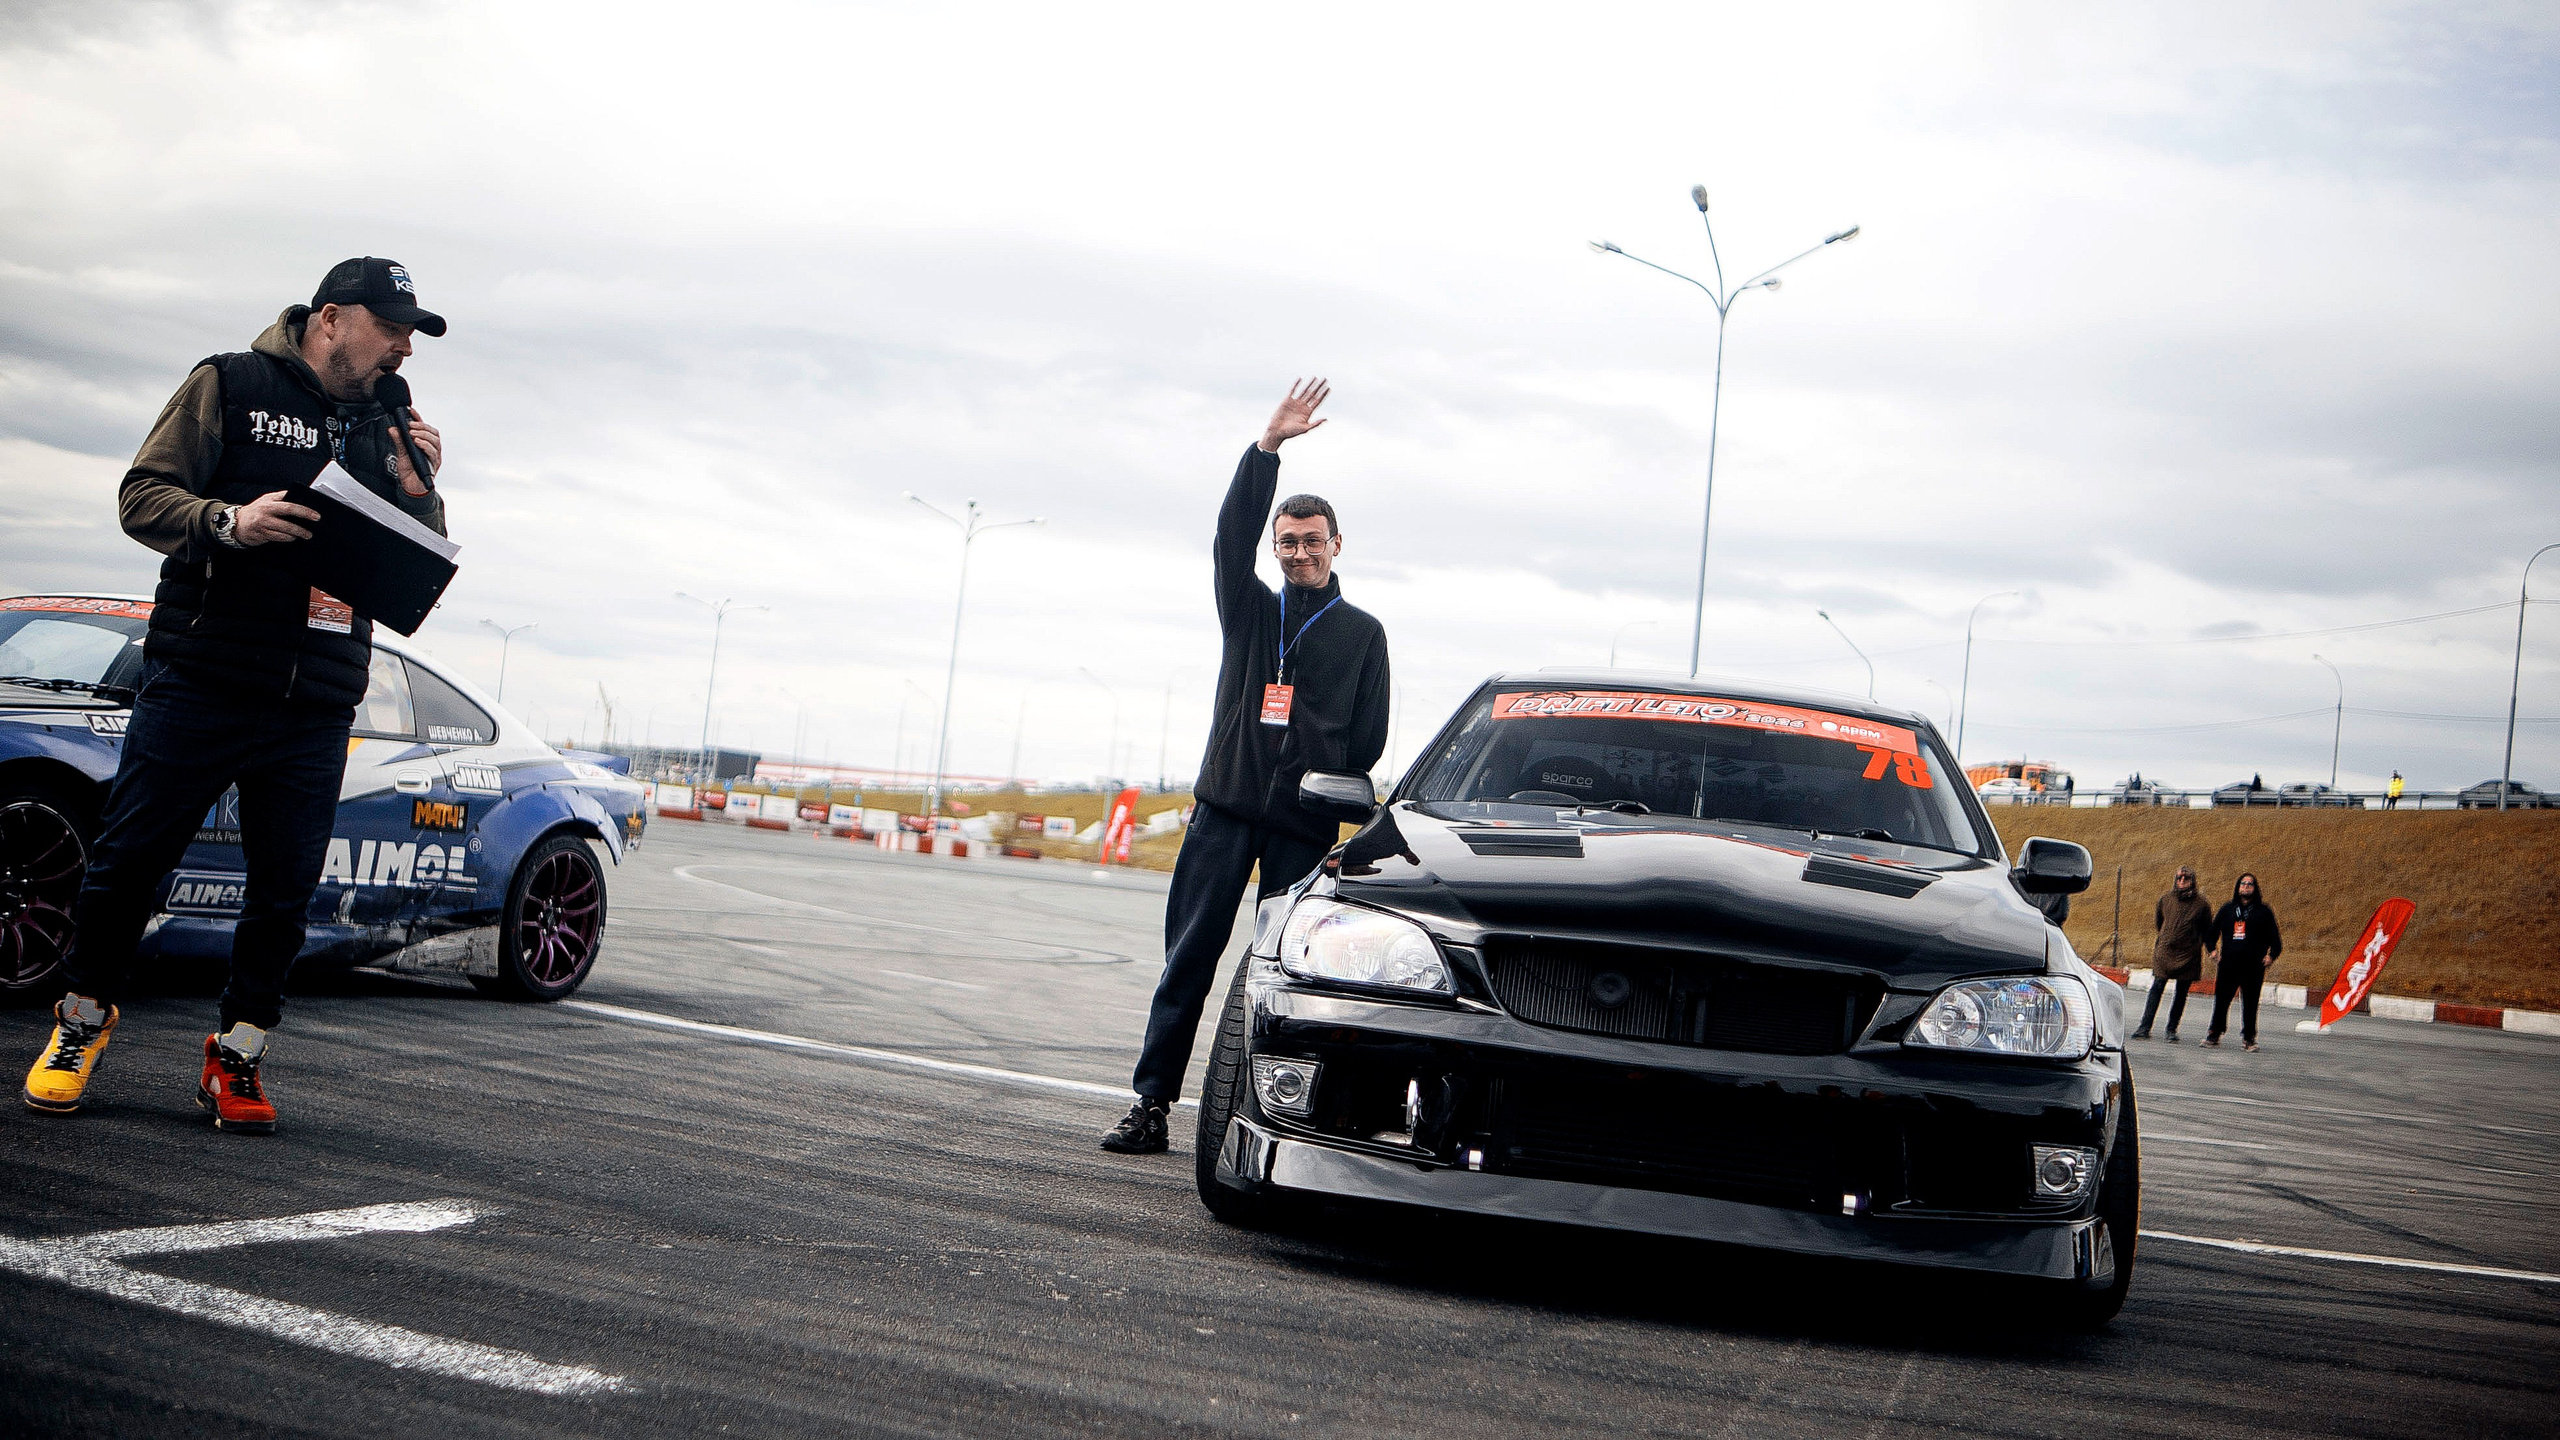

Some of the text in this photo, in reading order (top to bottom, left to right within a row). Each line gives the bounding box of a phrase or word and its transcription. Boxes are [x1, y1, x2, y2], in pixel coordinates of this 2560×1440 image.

[249, 410, 319, 449] Teddy
[255, 433, 301, 449] PLEIN
[1508, 697, 1635, 712] DRIFT
[1632, 698, 1737, 719] LETO
[428, 725, 473, 743] ШЕВЧЕНКО
[1856, 744, 1934, 789] 78
[1541, 771, 1593, 788] sparco
